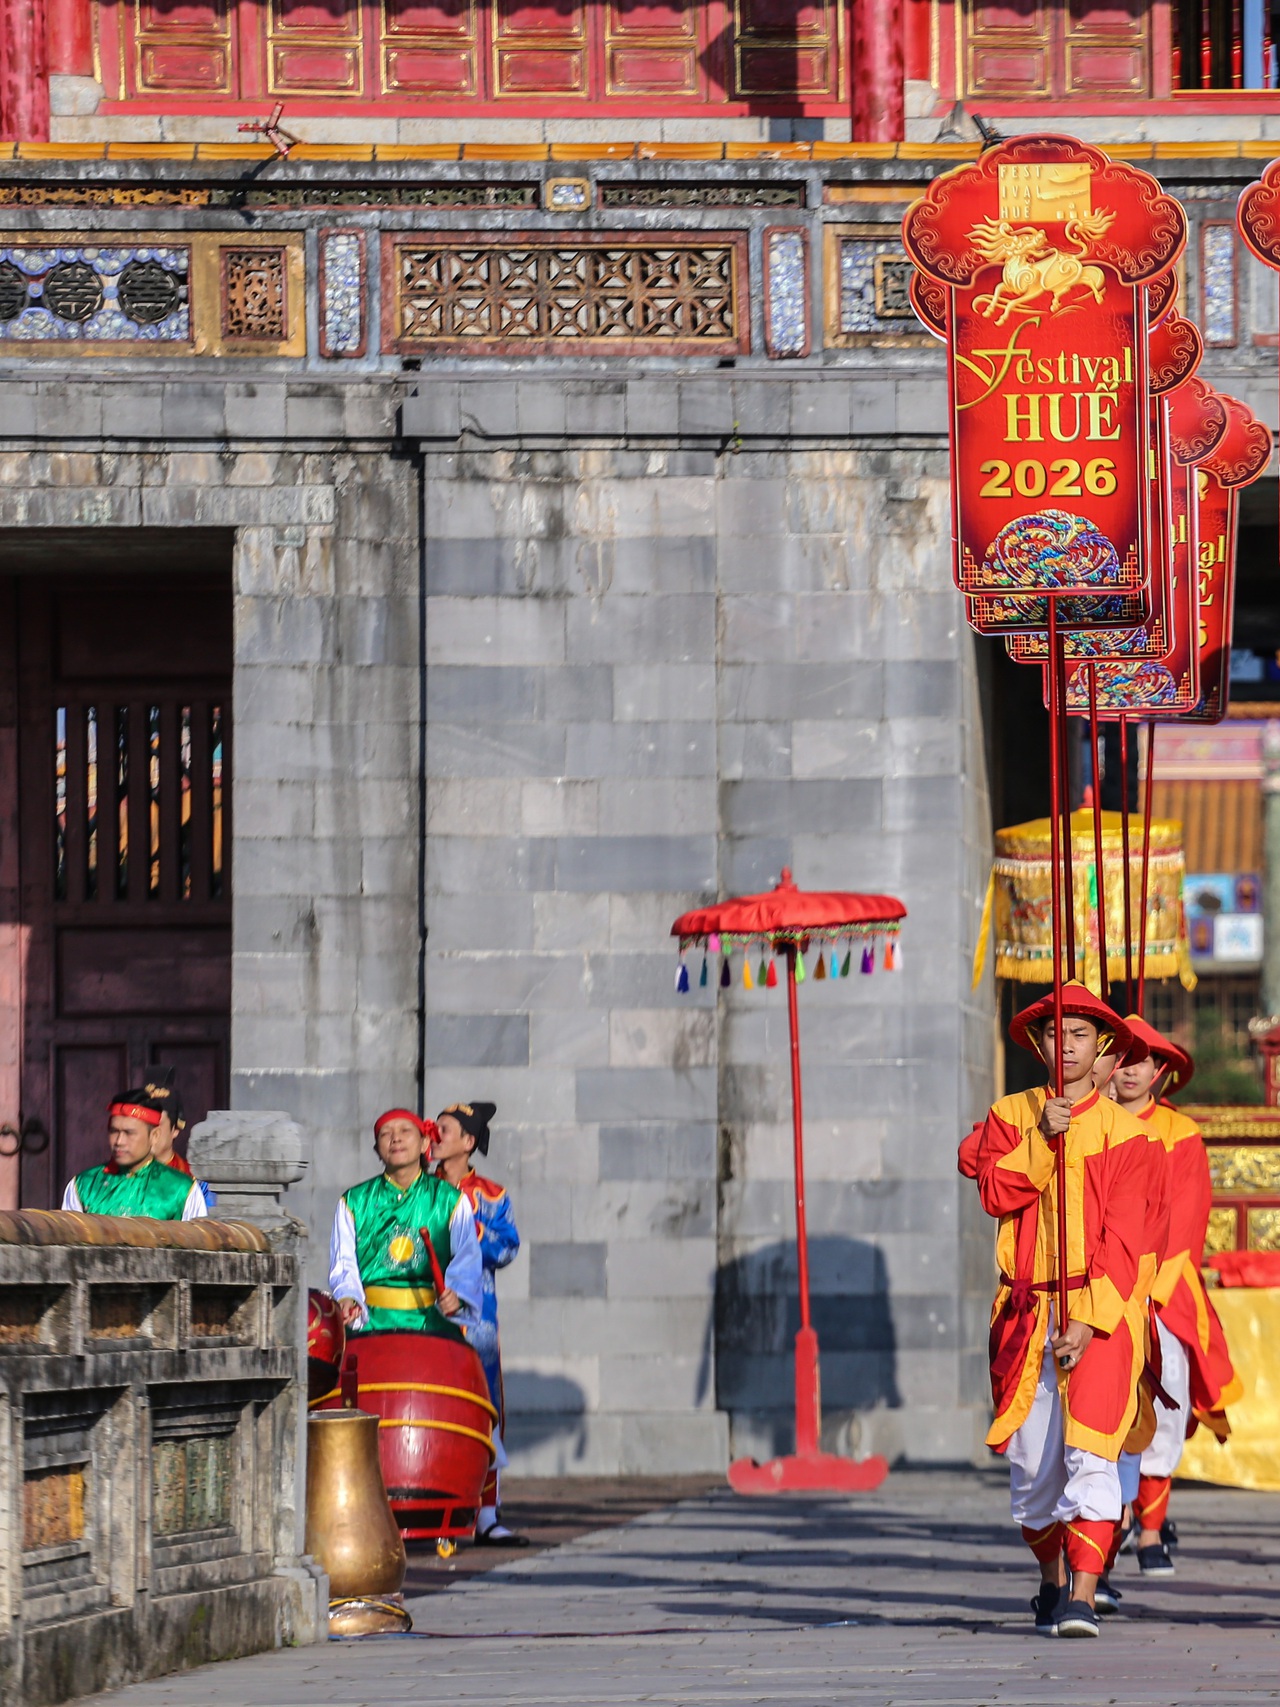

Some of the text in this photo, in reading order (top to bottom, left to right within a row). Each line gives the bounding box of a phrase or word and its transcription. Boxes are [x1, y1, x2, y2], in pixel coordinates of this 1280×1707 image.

[1000, 165, 1041, 178] FEST
[955, 316, 1134, 411] Festival
[1002, 381, 1122, 442] HUẾ
[979, 458, 1118, 498] 2026
